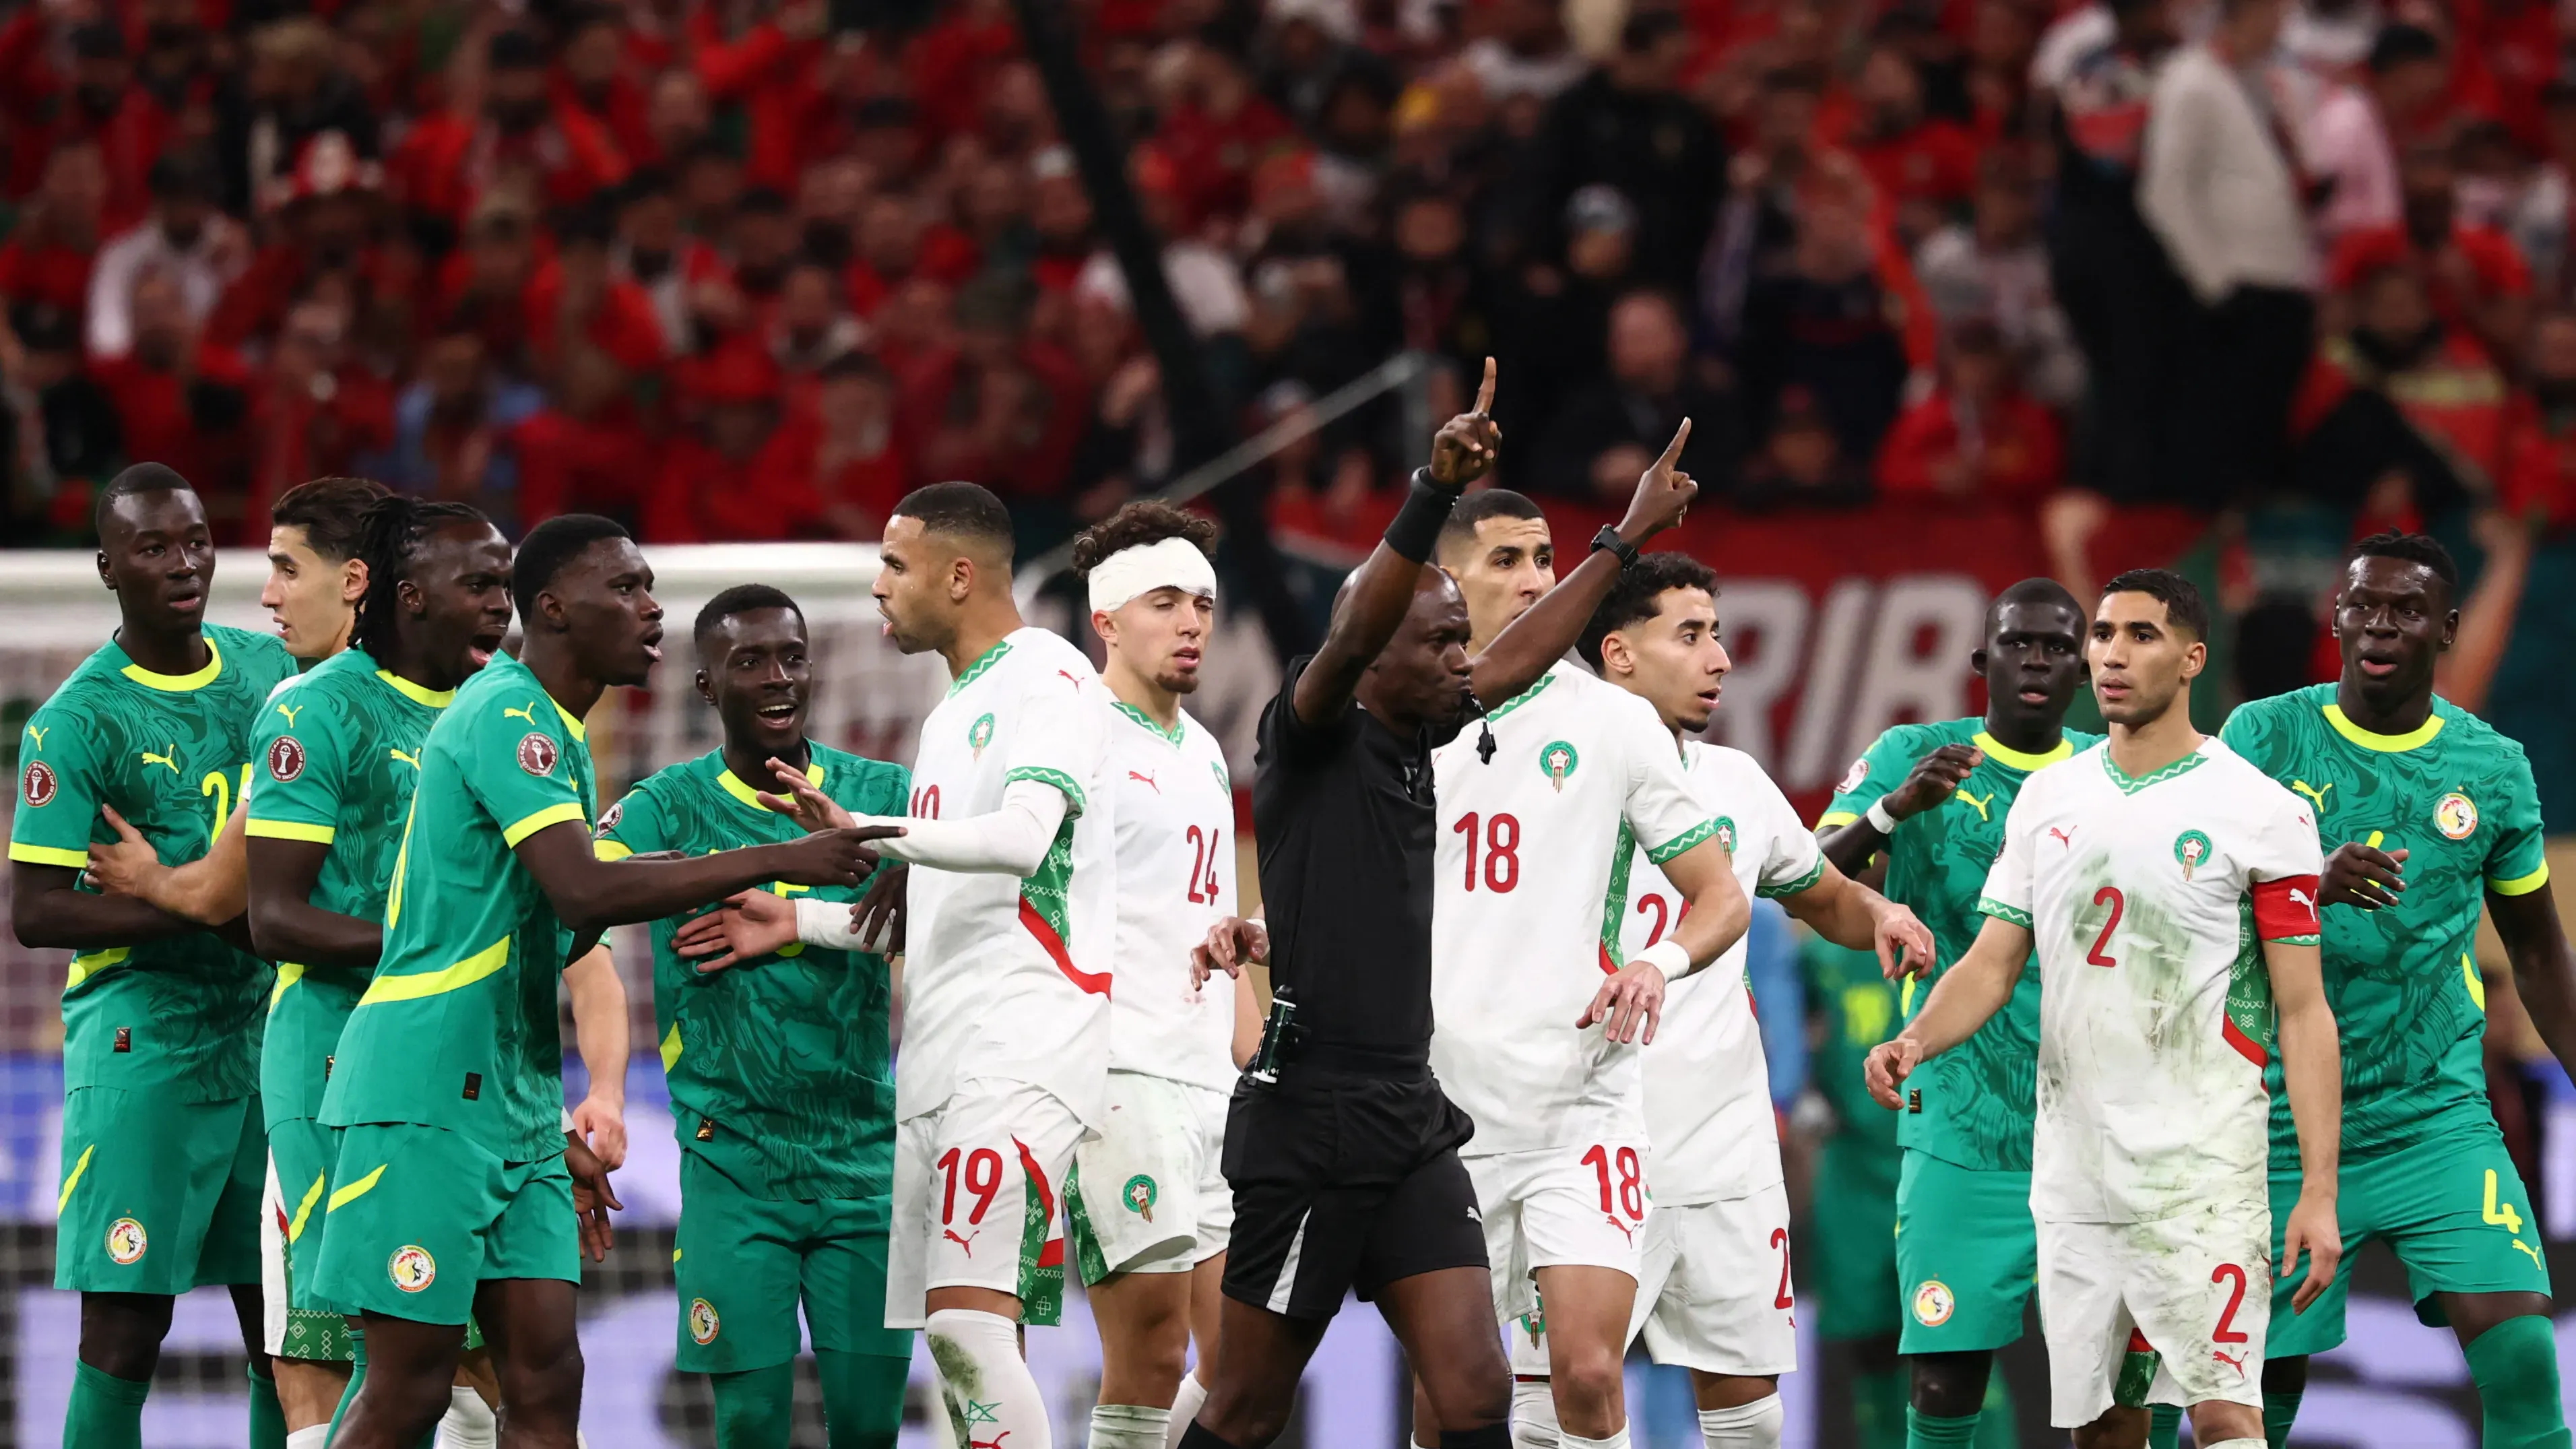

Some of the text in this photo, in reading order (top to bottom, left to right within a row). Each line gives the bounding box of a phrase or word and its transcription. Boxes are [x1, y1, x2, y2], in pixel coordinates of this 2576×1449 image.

[1186, 825, 1219, 907] 24
[1453, 812, 1520, 894] 18
[2086, 887, 2125, 967] 2
[937, 1147, 1004, 1226] 19
[1580, 1144, 1644, 1221] 18
[2483, 1169, 2522, 1234] 4
[2211, 1263, 2249, 1343] 2
